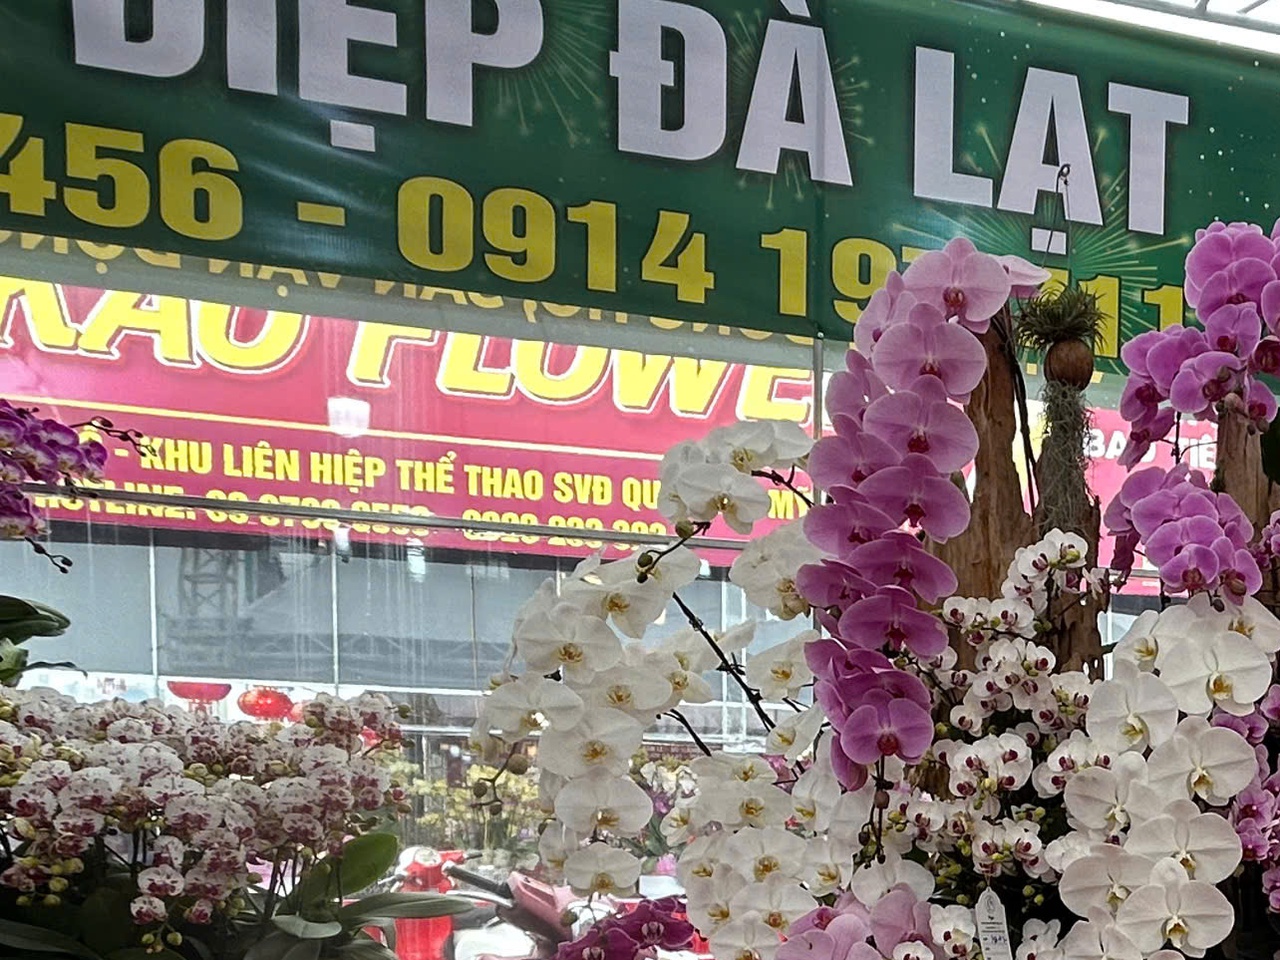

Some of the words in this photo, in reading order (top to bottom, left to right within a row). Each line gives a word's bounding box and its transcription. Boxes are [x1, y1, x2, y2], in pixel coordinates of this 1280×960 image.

[608, 0, 853, 187] ĐÀ
[913, 45, 1189, 256] LẠT
[397, 175, 715, 304] 0914
[760, 228, 932, 326] 19
[1028, 267, 1184, 358] 11
[140, 436, 213, 475] KHU
[223, 439, 300, 483] LIÊN
[310, 448, 385, 494] HIỆP
[396, 450, 455, 494] THỂ
[463, 465, 543, 502] THAO
[553, 472, 611, 505] SVĐ
[622, 477, 661, 512] QU
